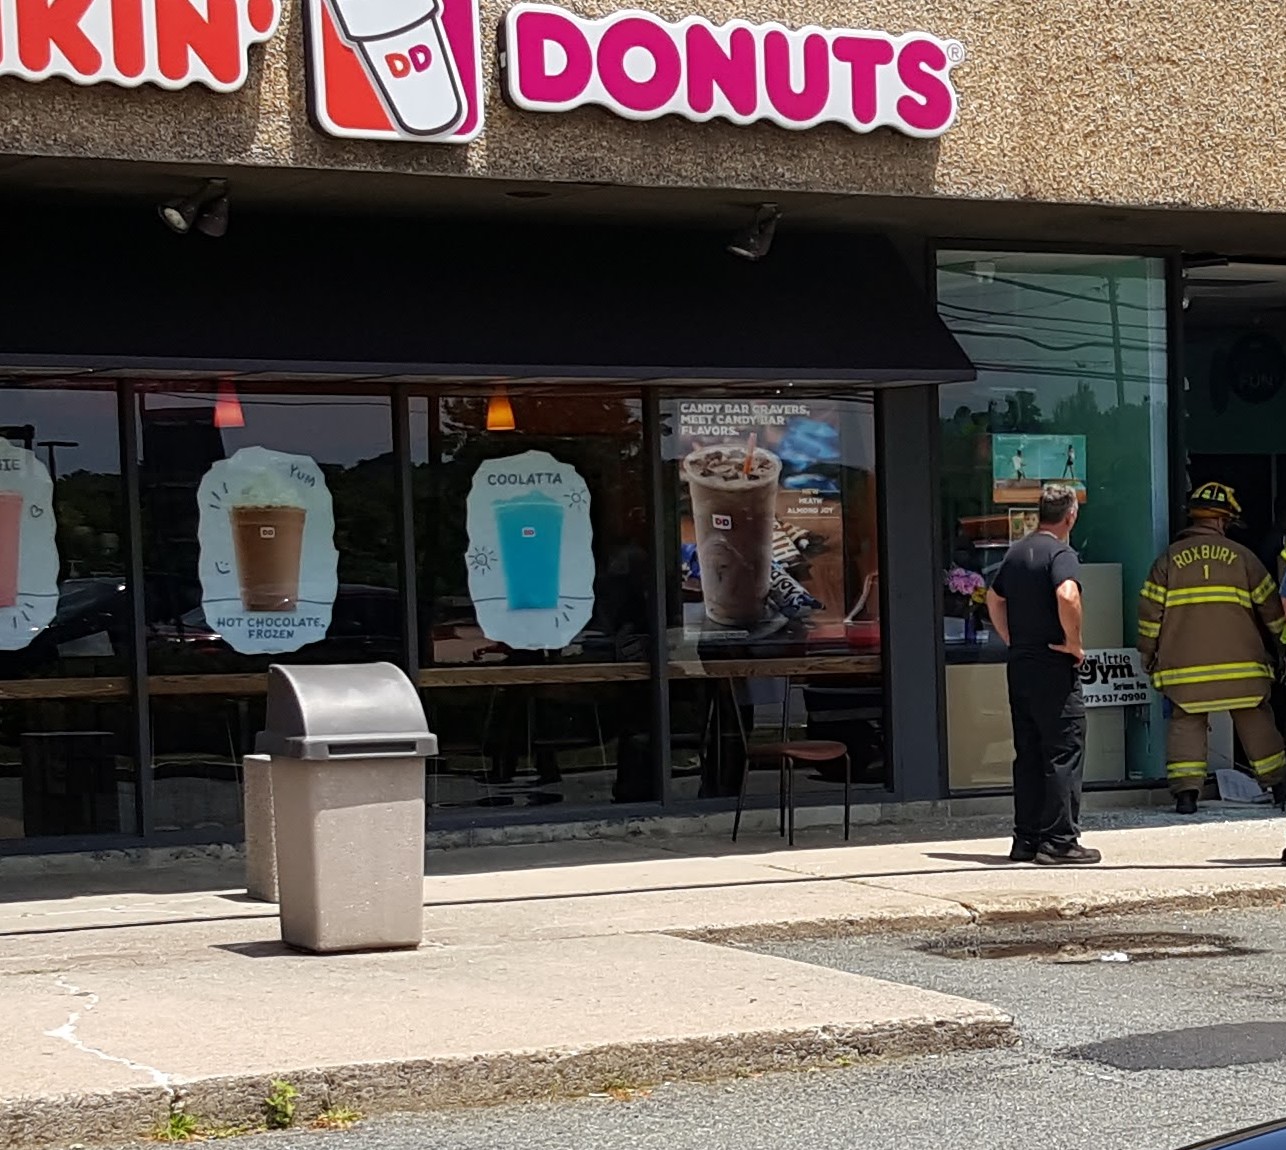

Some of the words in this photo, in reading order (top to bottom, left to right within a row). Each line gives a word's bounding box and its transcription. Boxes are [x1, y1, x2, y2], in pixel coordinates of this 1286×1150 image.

[385, 45, 432, 79] DD
[516, 11, 952, 130] DONUTS
[680, 403, 722, 414] CANDY
[724, 403, 749, 414] BAR
[751, 404, 811, 416] CRAVERS,
[680, 415, 713, 425] MEET
[716, 415, 755, 425] CANDY
[681, 425, 740, 436] FLAVORS.
[290, 463, 316, 488] YUM
[487, 473, 562, 486] COOLATTA
[1172, 544, 1238, 569] ROXBURY
[1203, 564, 1209, 580] 1
[217, 617, 243, 628] HOT
[247, 617, 326, 629] CHOCOLATE,
[248, 629, 294, 639] FROZEN
[1096, 652, 1131, 665] Little
